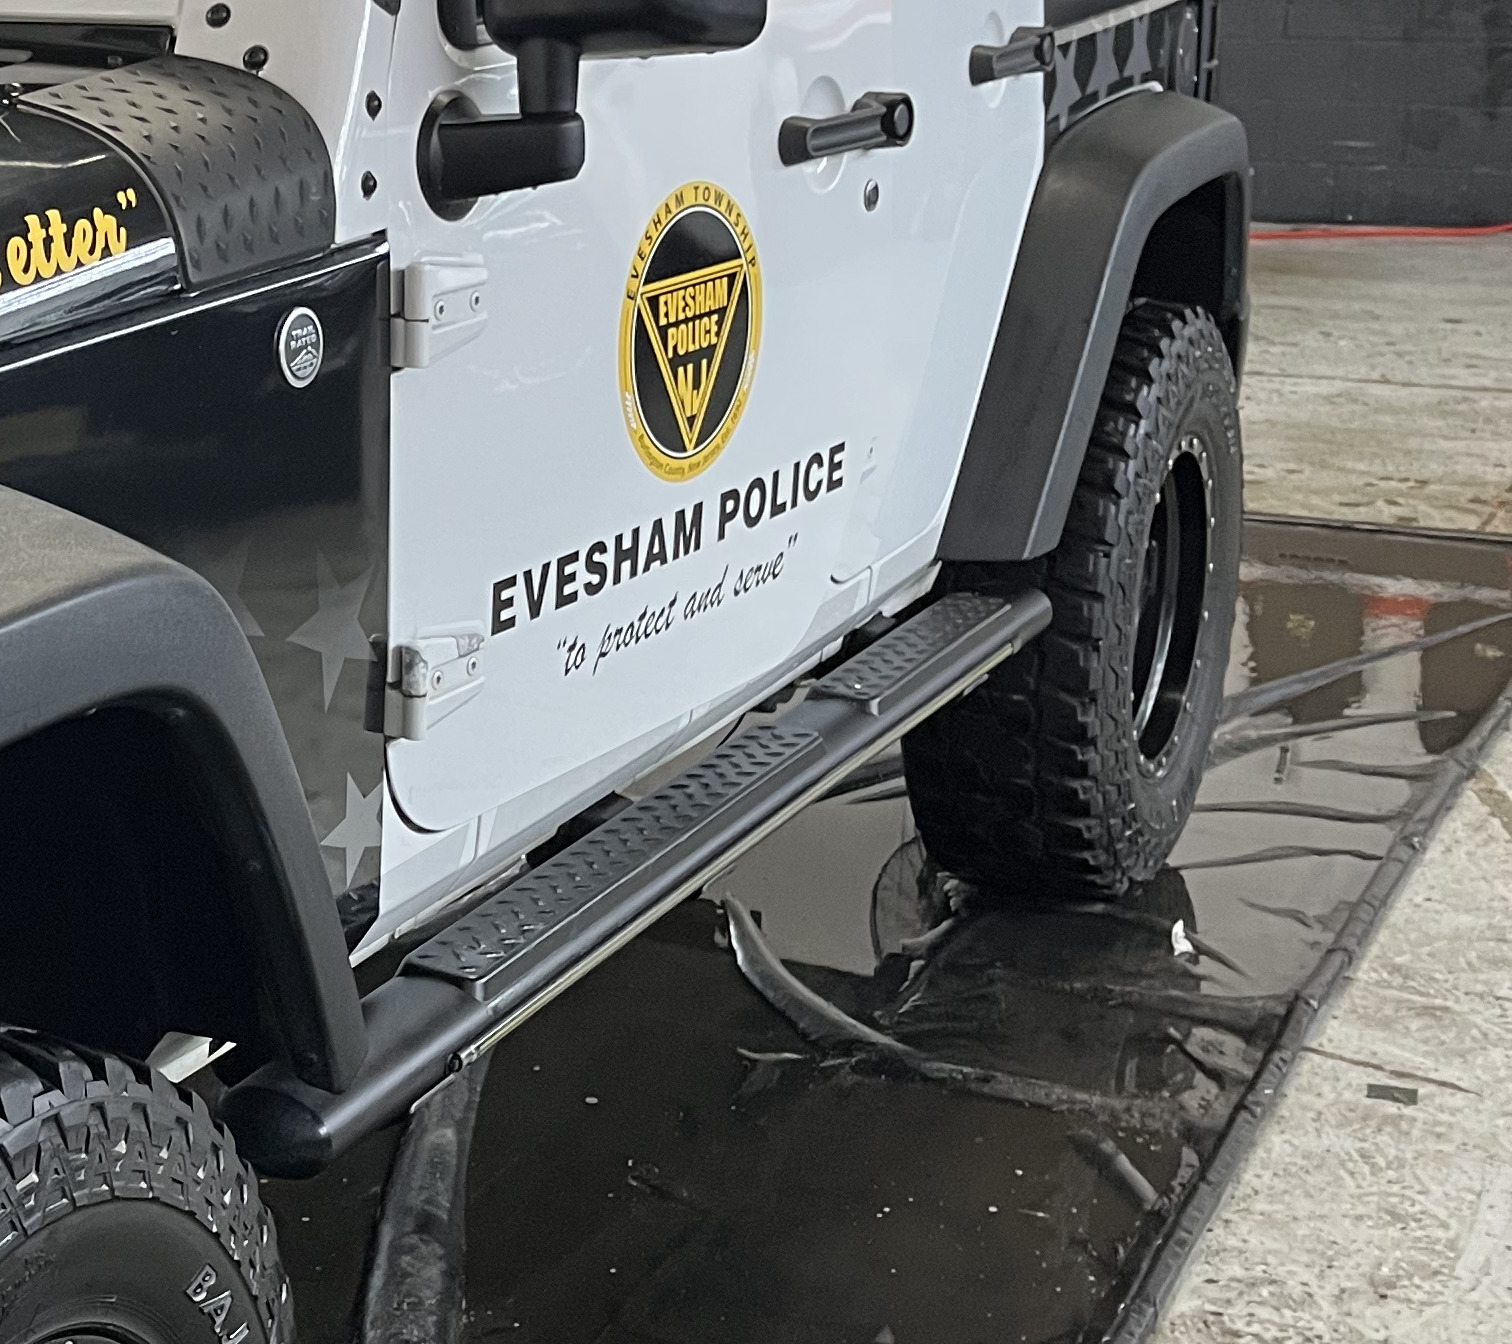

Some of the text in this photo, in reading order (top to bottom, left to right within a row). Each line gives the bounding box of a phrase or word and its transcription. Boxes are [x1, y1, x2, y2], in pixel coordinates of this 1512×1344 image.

[627, 184, 757, 301] EVESHAM TOWNSHIP
[658, 275, 729, 327] EVESHAM
[666, 313, 720, 360] POLICE
[676, 358, 708, 417] NJ
[489, 441, 847, 637] EVESHAM POLICE
[592, 591, 679, 676] protect
[683, 563, 730, 621] and
